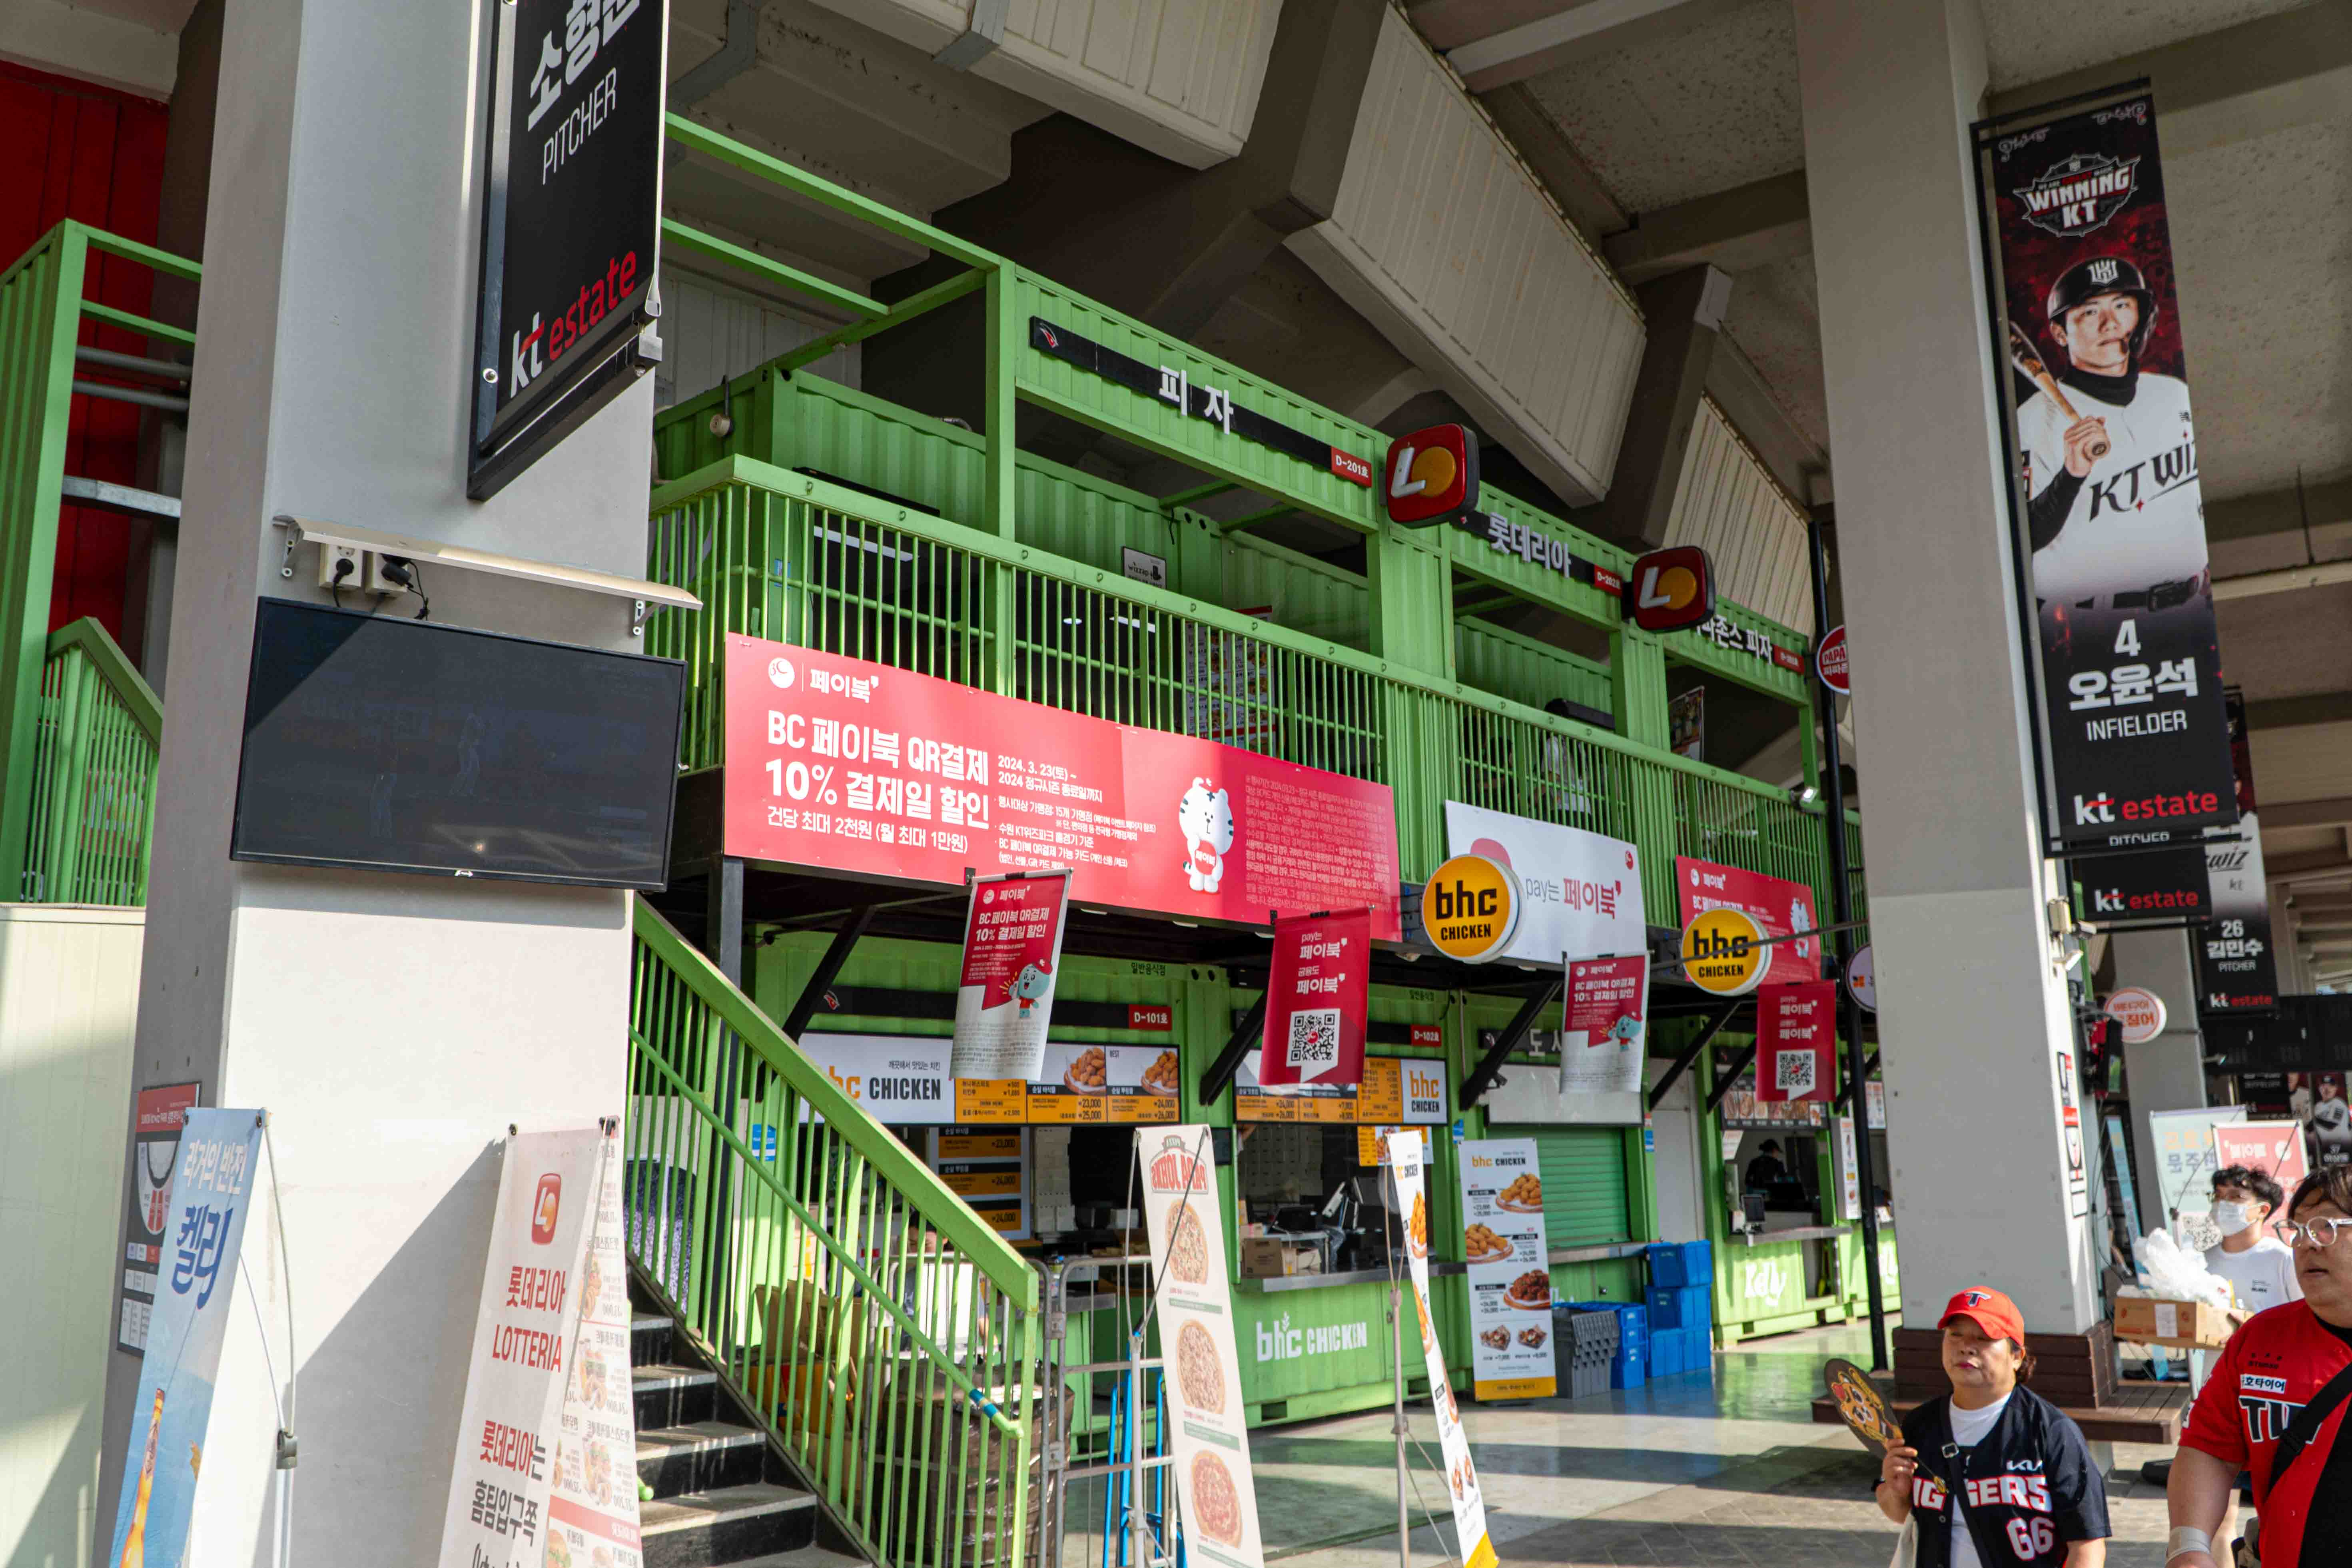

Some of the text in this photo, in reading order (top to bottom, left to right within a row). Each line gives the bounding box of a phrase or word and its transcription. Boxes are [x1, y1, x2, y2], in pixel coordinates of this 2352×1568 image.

[543, 67, 616, 185] PITCHER
[2027, 166, 2132, 212] WINNING
[2063, 200, 2098, 228] KT
[510, 250, 636, 398] kt estate
[1335, 455, 1369, 478] D-201호
[1488, 512, 1571, 578] 롯데리아
[1697, 614, 1772, 666] 파존스 피자
[2115, 619, 2141, 657] 4
[810, 668, 871, 704] 페이북
[2069, 656, 2198, 712] 오윤석
[2087, 709, 2187, 742] INFIELDER
[768, 710, 989, 786] BC 페이북 QR결제
[998, 755, 1026, 773] 2024.
[1028, 761, 1038, 775] 3.
[766, 758, 989, 830] 10% 결제일 할인
[998, 772, 1023, 788] 2024
[2074, 791, 2218, 826] kt estate
[767, 806, 968, 854] 건당 최대 2천원 (월 최대 1만원)
[999, 888, 1026, 901] 페이북
[1436, 880, 1497, 920] bhc
[1525, 878, 1560, 903] pay는
[2094, 888, 2198, 912] kt estate
[979, 907, 1049, 925] BC 페이북 QR결제
[2221, 920, 2244, 938] 26
[976, 924, 1046, 942] 10% 결제일 할인
[1440, 924, 1491, 941] CHICKEN
[1299, 942, 1341, 960] 페이북
[2206, 938, 2264, 959] 김민수
[1131, 962, 1166, 976] 일반음식점
[1699, 964, 1744, 978] CHICKEN
[2218, 961, 2256, 972] PITCHER
[1296, 977, 1338, 995] 페이북
[2210, 993, 2272, 1008] kt estate
[1134, 1011, 1168, 1024] D-101호
[930, 1061, 941, 1071] 치킨
[869, 1077, 941, 1100] CHICKEN
[1409, 1070, 1440, 1099] bhc
[1411, 1100, 1440, 1113] CHICKEN
[184, 1139, 248, 1195] 라거의 반전
[1495, 1157, 1526, 1167] CHICKEN
[171, 1203, 234, 1310] 켈리
[507, 1266, 566, 1314] 롯데리아
[492, 1323, 562, 1373] LOTTERIA
[1255, 1319, 1368, 1363] bhc CHICKEN
[2242, 1376, 2286, 1393] 호타이어
[480, 1419, 547, 1482] 롯데리아는
[471, 1479, 538, 1547] 홈팀입구쪽
[2007, 1516, 2055, 1561] 66
